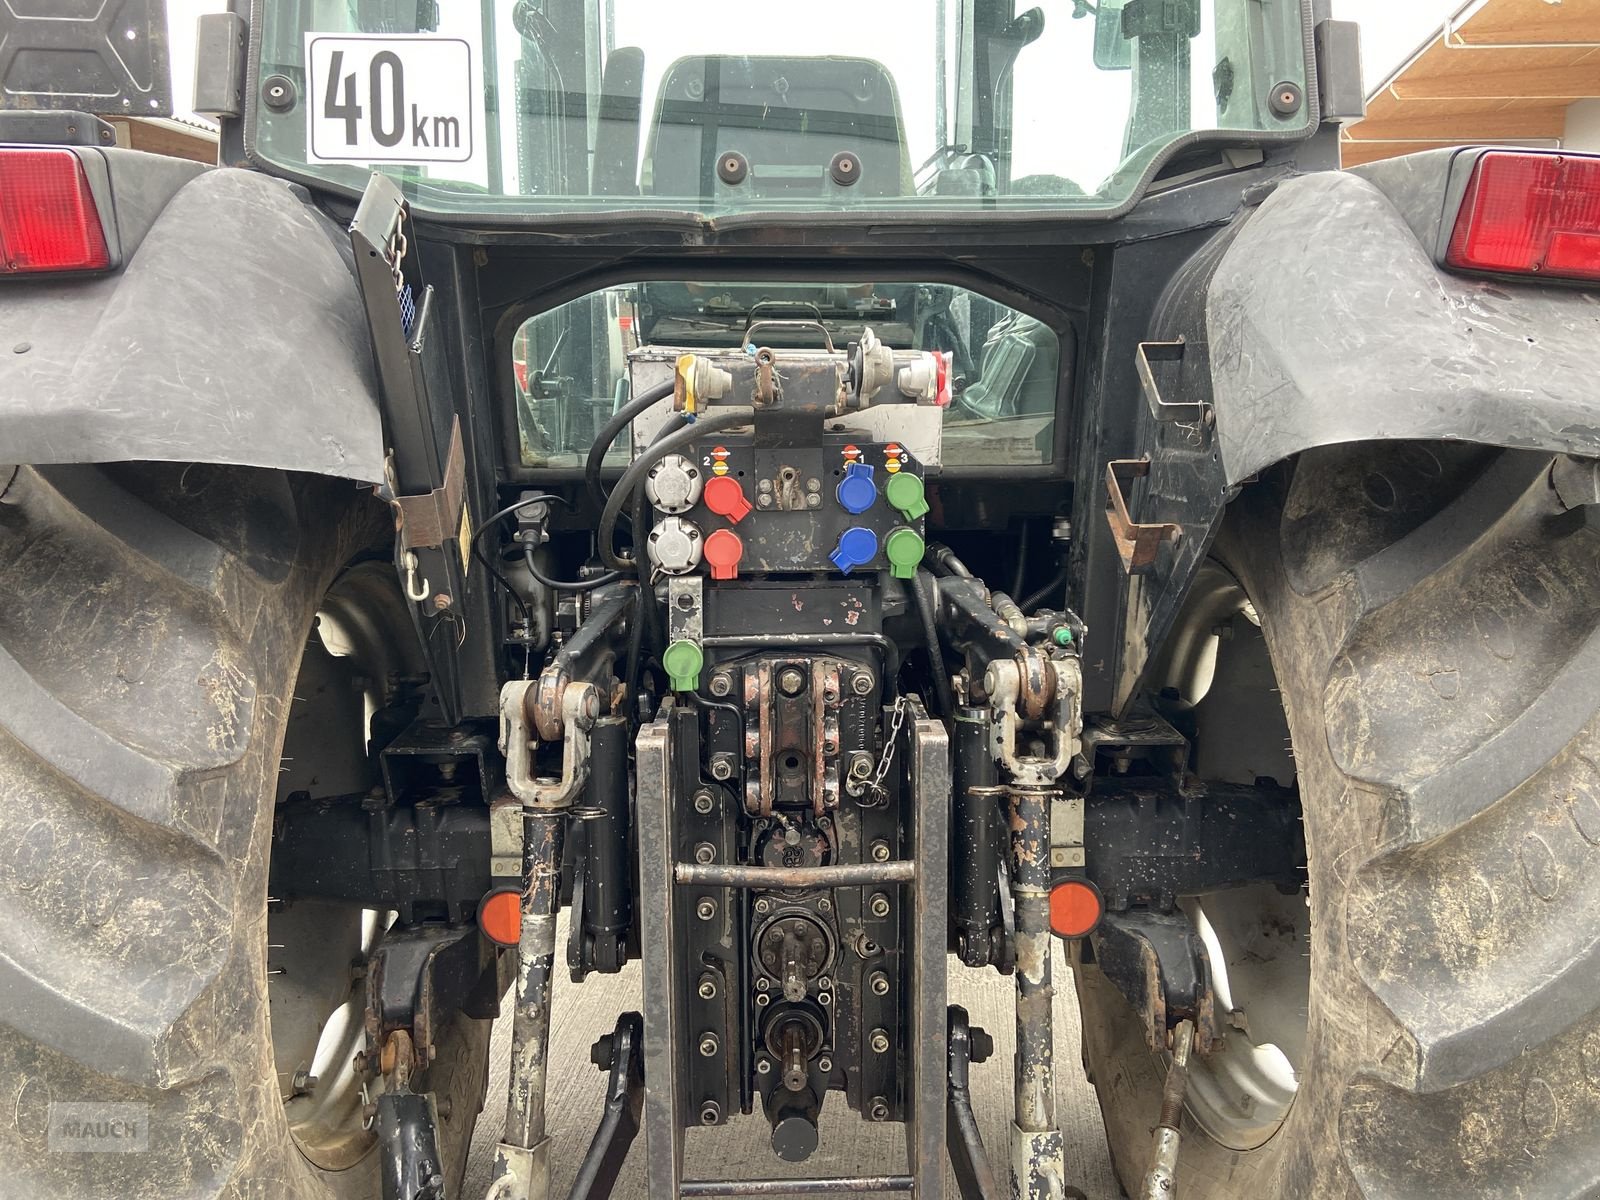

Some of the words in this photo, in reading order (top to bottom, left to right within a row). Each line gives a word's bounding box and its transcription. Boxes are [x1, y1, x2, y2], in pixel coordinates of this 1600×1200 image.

[703, 456, 711, 466] 2
[859, 454, 865, 464] 1
[900, 453, 909, 463] 3
